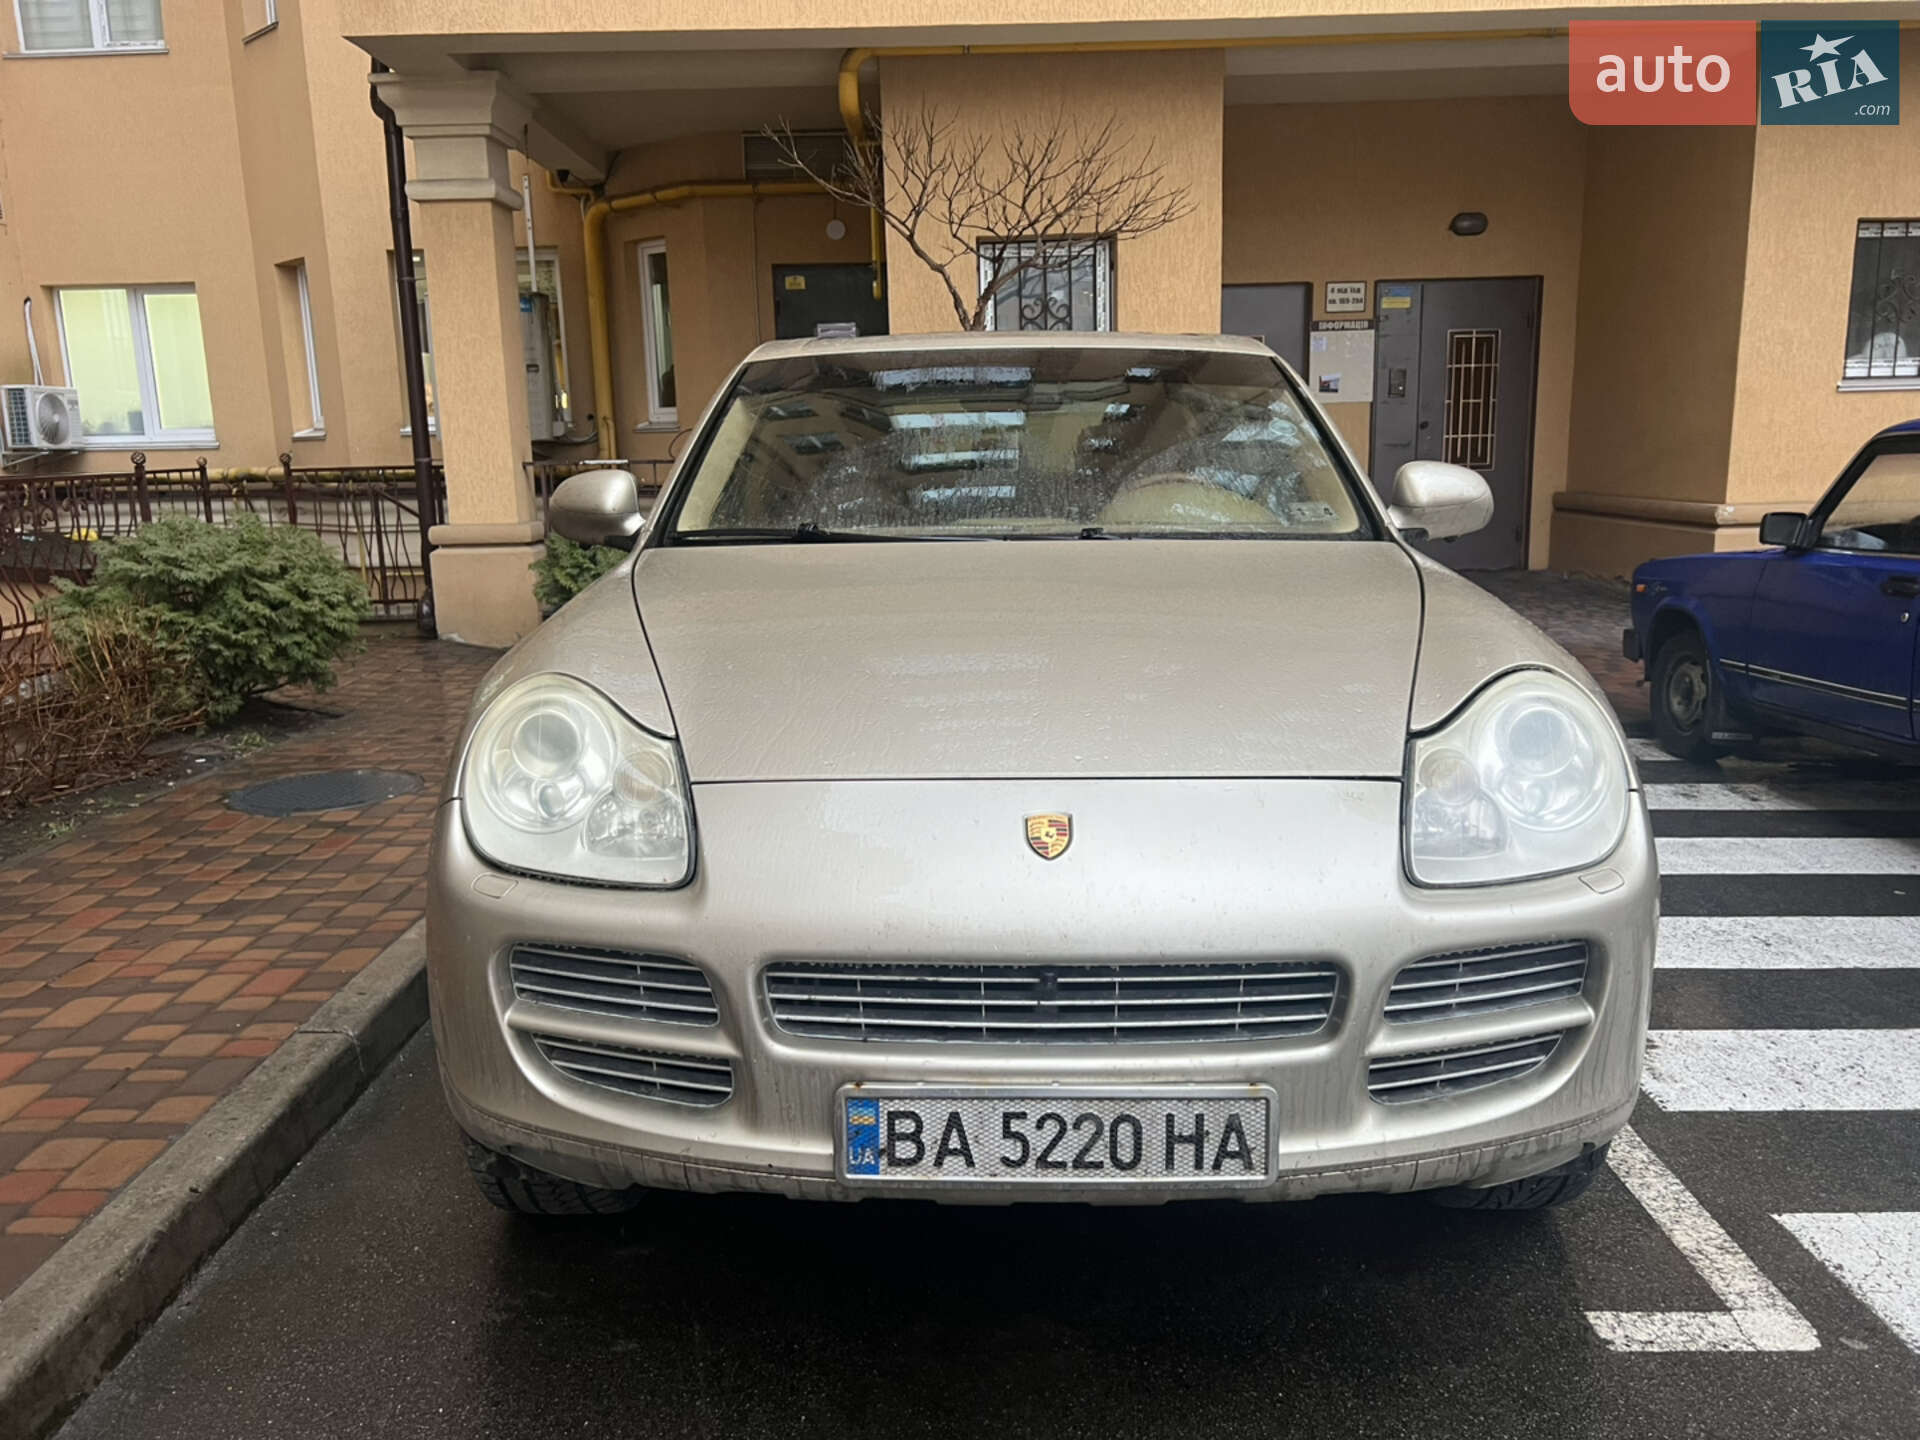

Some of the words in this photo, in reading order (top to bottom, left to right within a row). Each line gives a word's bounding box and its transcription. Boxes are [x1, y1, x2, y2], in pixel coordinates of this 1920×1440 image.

[848, 1145, 876, 1165] UA
[886, 1110, 975, 1169] BA
[999, 1111, 1143, 1171] 5220
[1165, 1112, 1255, 1171] HA
